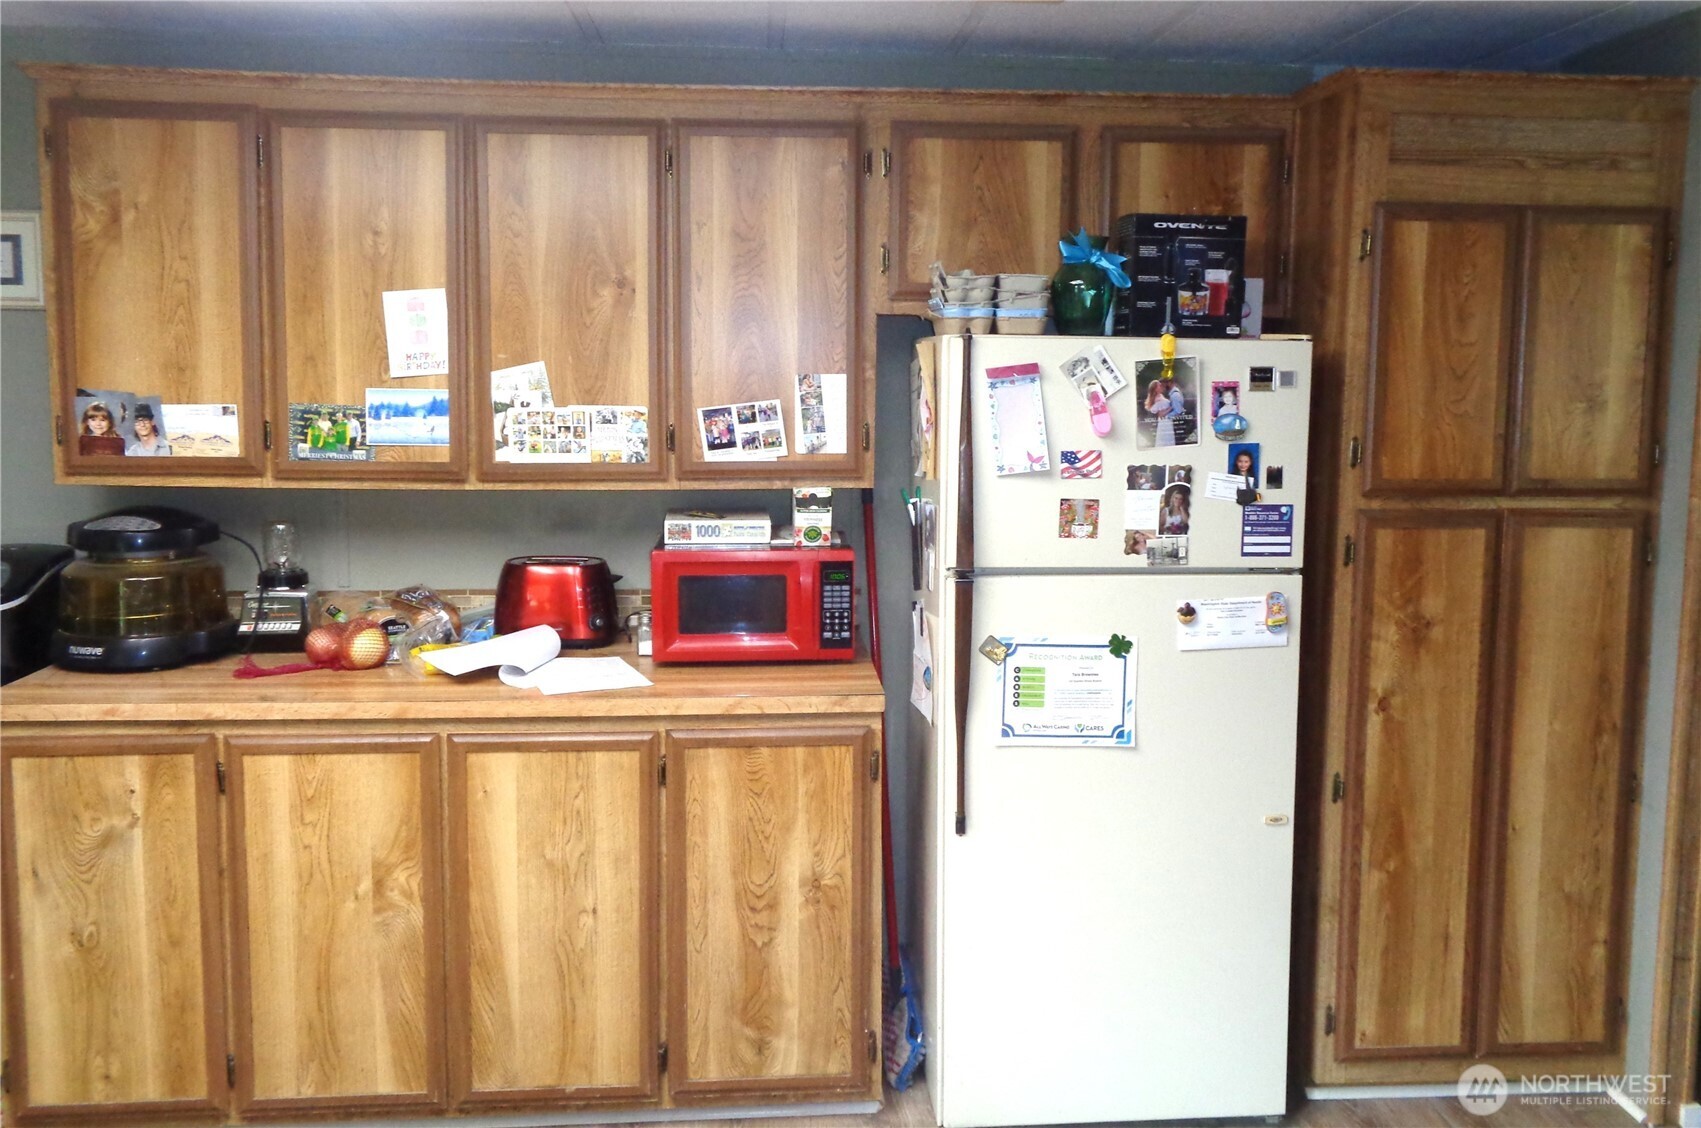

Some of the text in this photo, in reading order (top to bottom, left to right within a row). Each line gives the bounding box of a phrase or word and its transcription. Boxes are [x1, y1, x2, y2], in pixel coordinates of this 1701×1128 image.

[405, 352, 436, 361] HAPPY
[696, 524, 720, 538] 1000
[69, 646, 104, 656] nuwave
